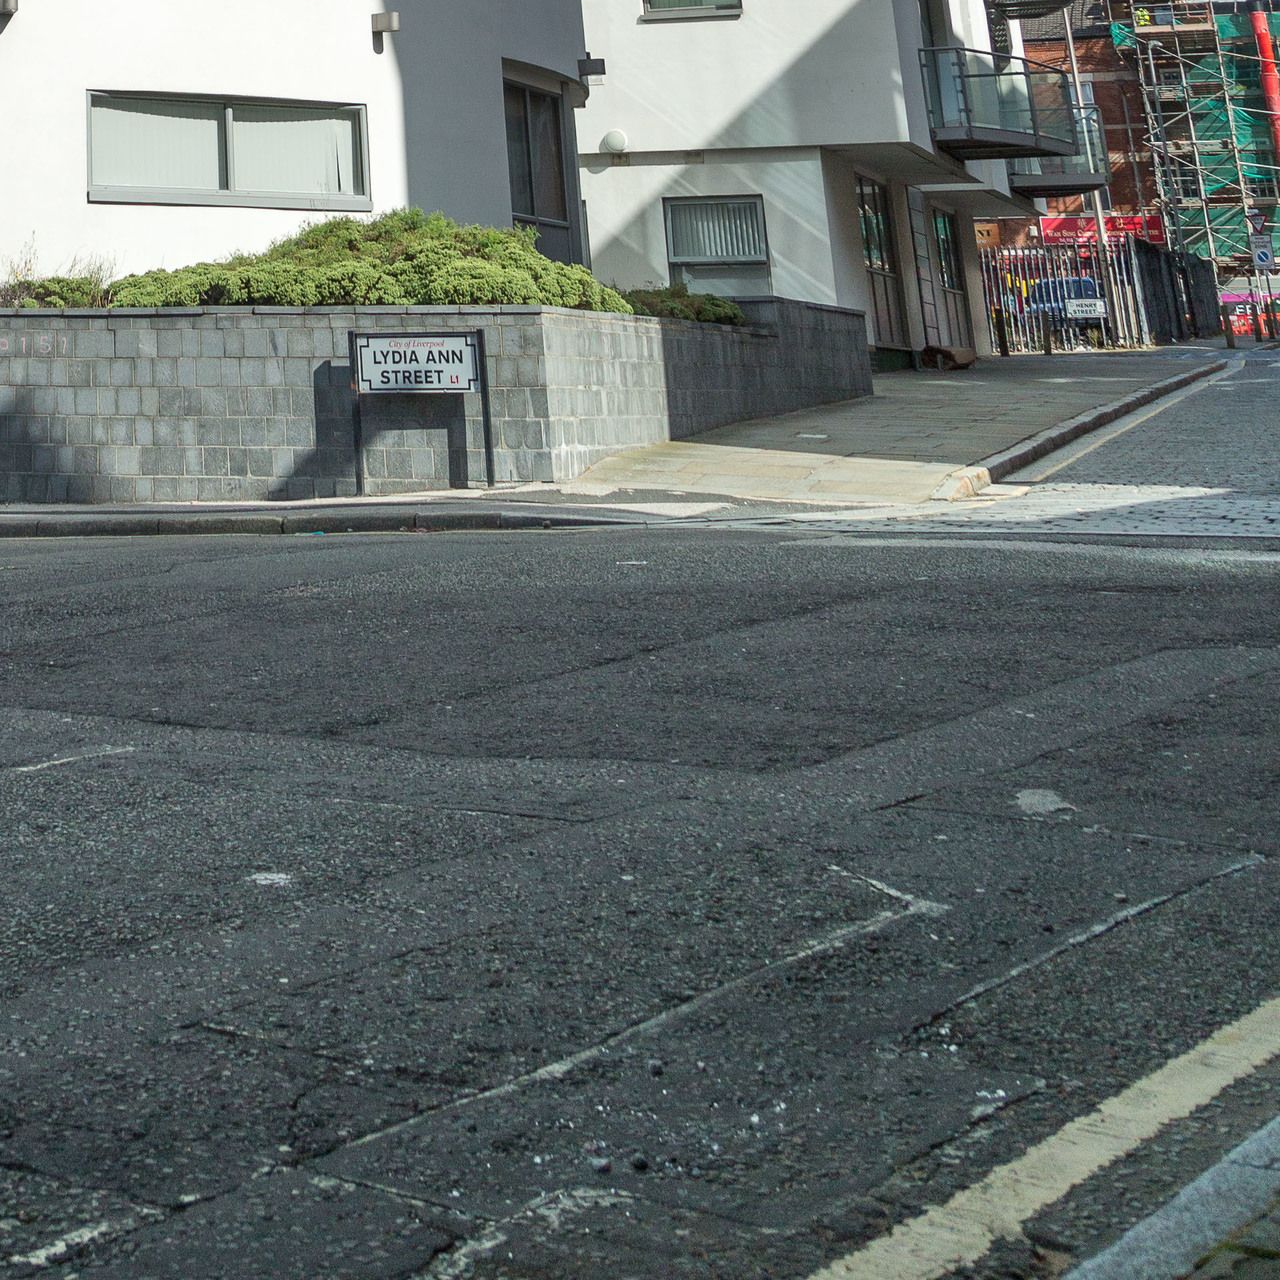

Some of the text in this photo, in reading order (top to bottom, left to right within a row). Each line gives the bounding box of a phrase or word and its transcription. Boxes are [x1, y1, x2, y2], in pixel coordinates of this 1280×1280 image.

[388, 340, 445, 350] City of Liverpool
[373, 349, 464, 365] LYDIA ANN
[380, 369, 459, 385] STREET L1
